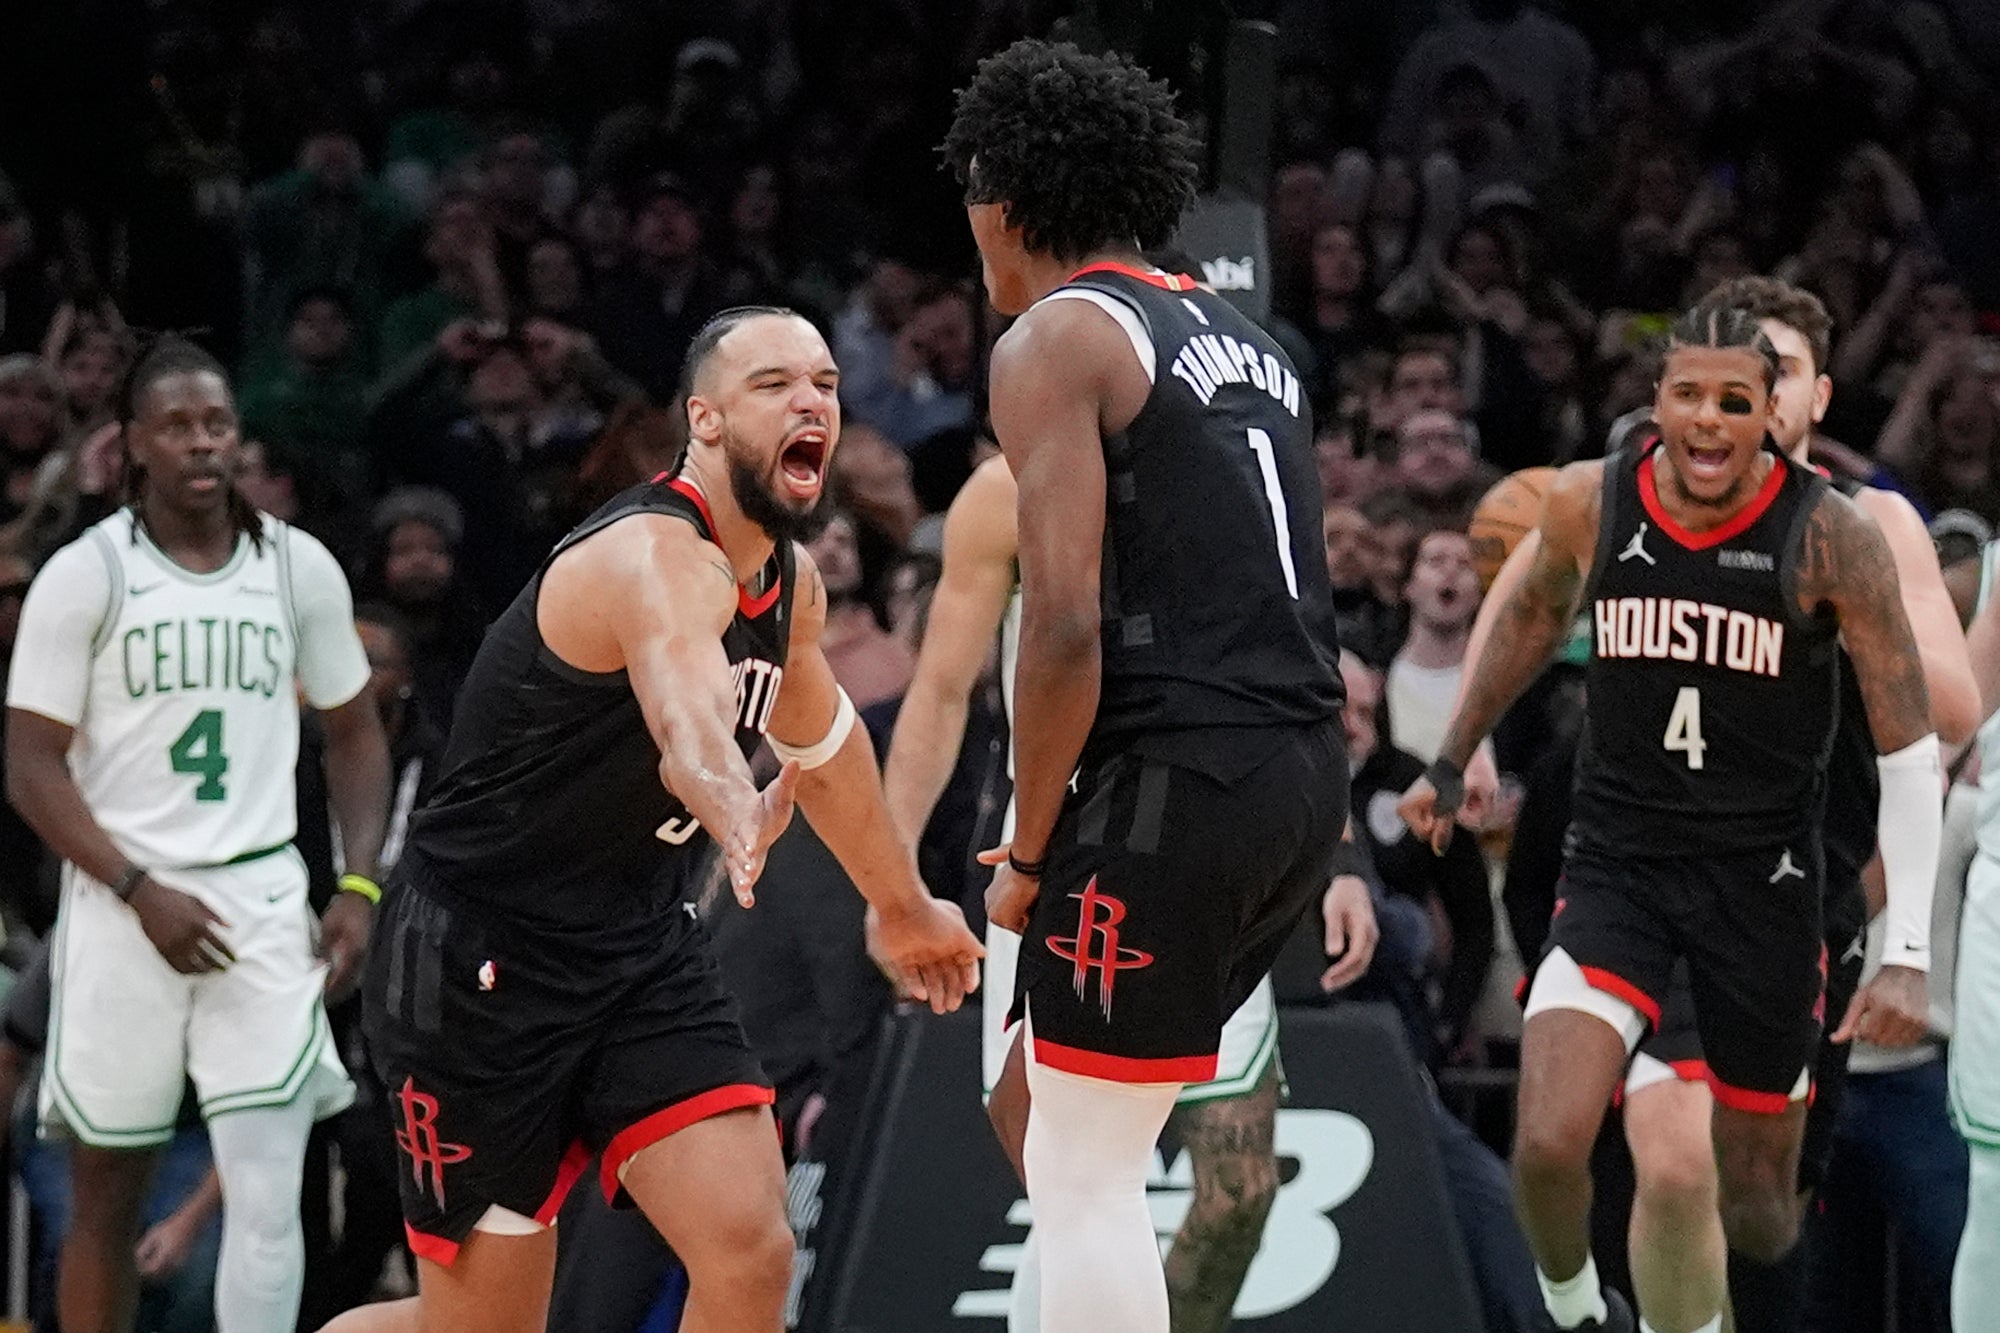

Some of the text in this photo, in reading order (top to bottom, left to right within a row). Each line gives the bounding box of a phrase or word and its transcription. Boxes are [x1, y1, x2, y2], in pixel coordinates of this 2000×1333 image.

[1171, 334, 1300, 418] THOMPSON
[1246, 427, 1300, 601] 1
[123, 617, 283, 699] CELTICS
[1595, 597, 1784, 678] HOUSTON
[170, 710, 228, 801] 4
[1663, 686, 1708, 771] 4
